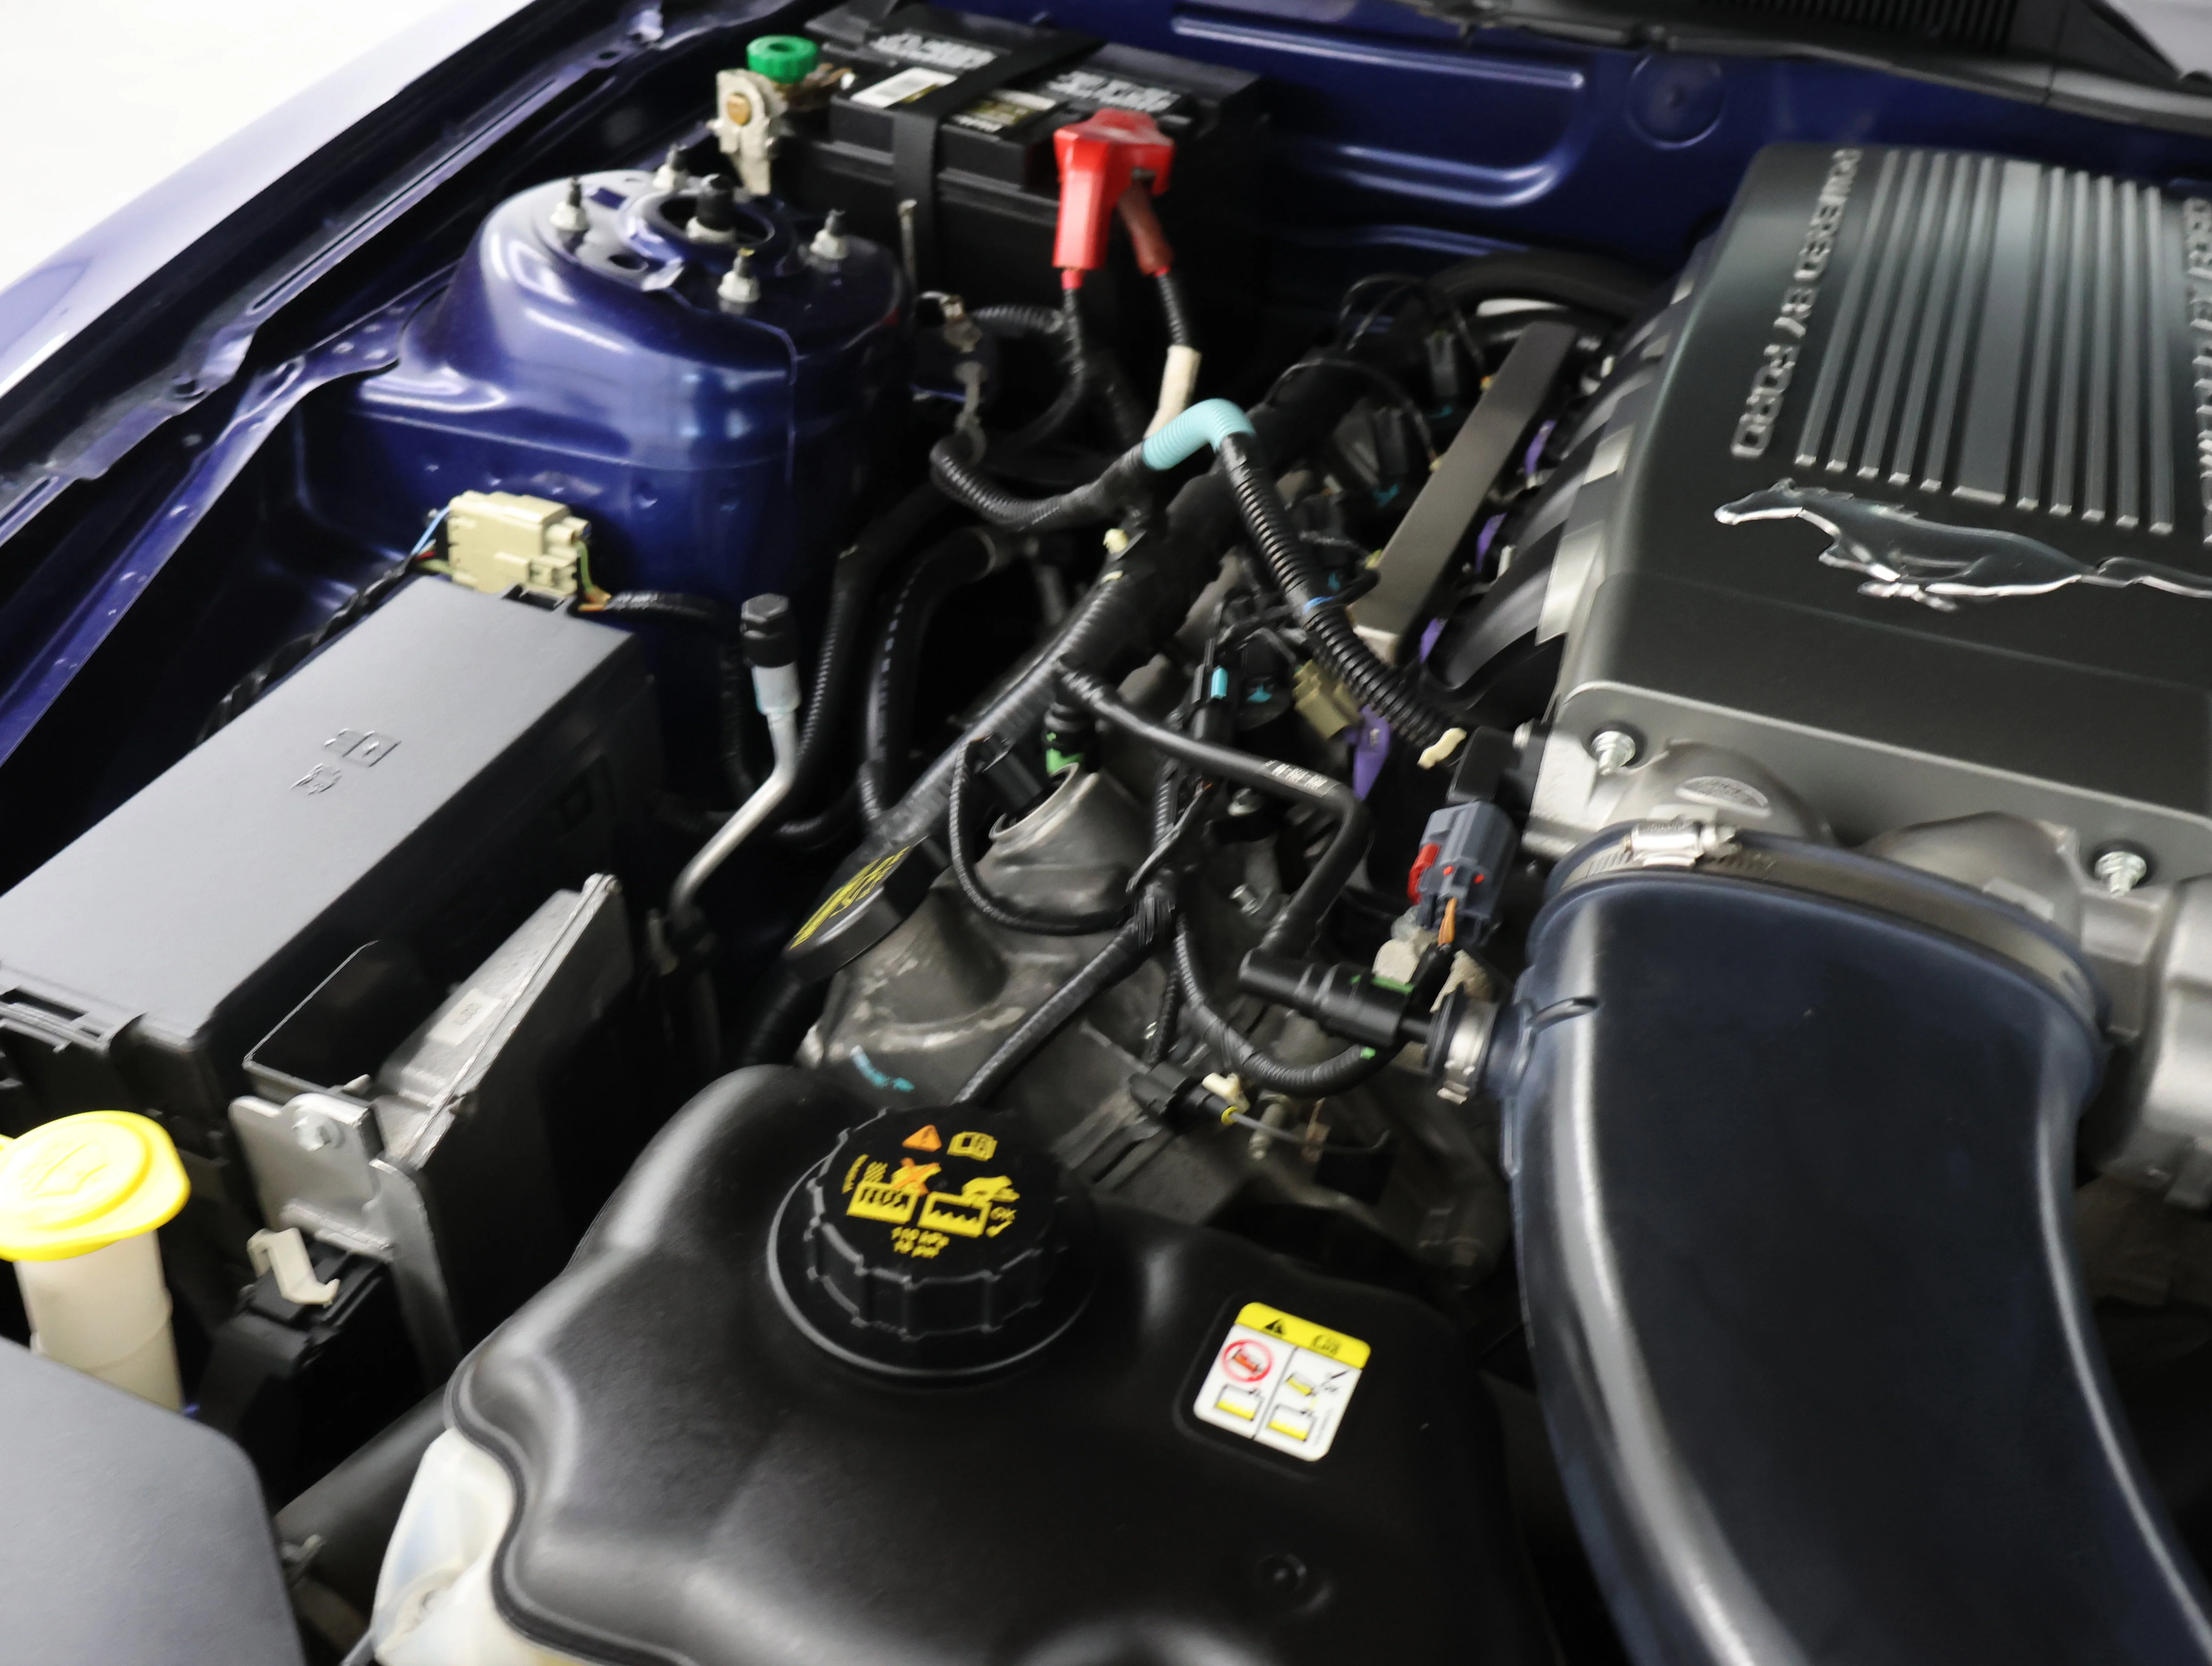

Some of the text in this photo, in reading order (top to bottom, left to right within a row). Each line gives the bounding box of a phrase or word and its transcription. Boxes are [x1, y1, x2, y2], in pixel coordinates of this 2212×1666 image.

[1731, 148, 1863, 458] POWERED BY FORD
